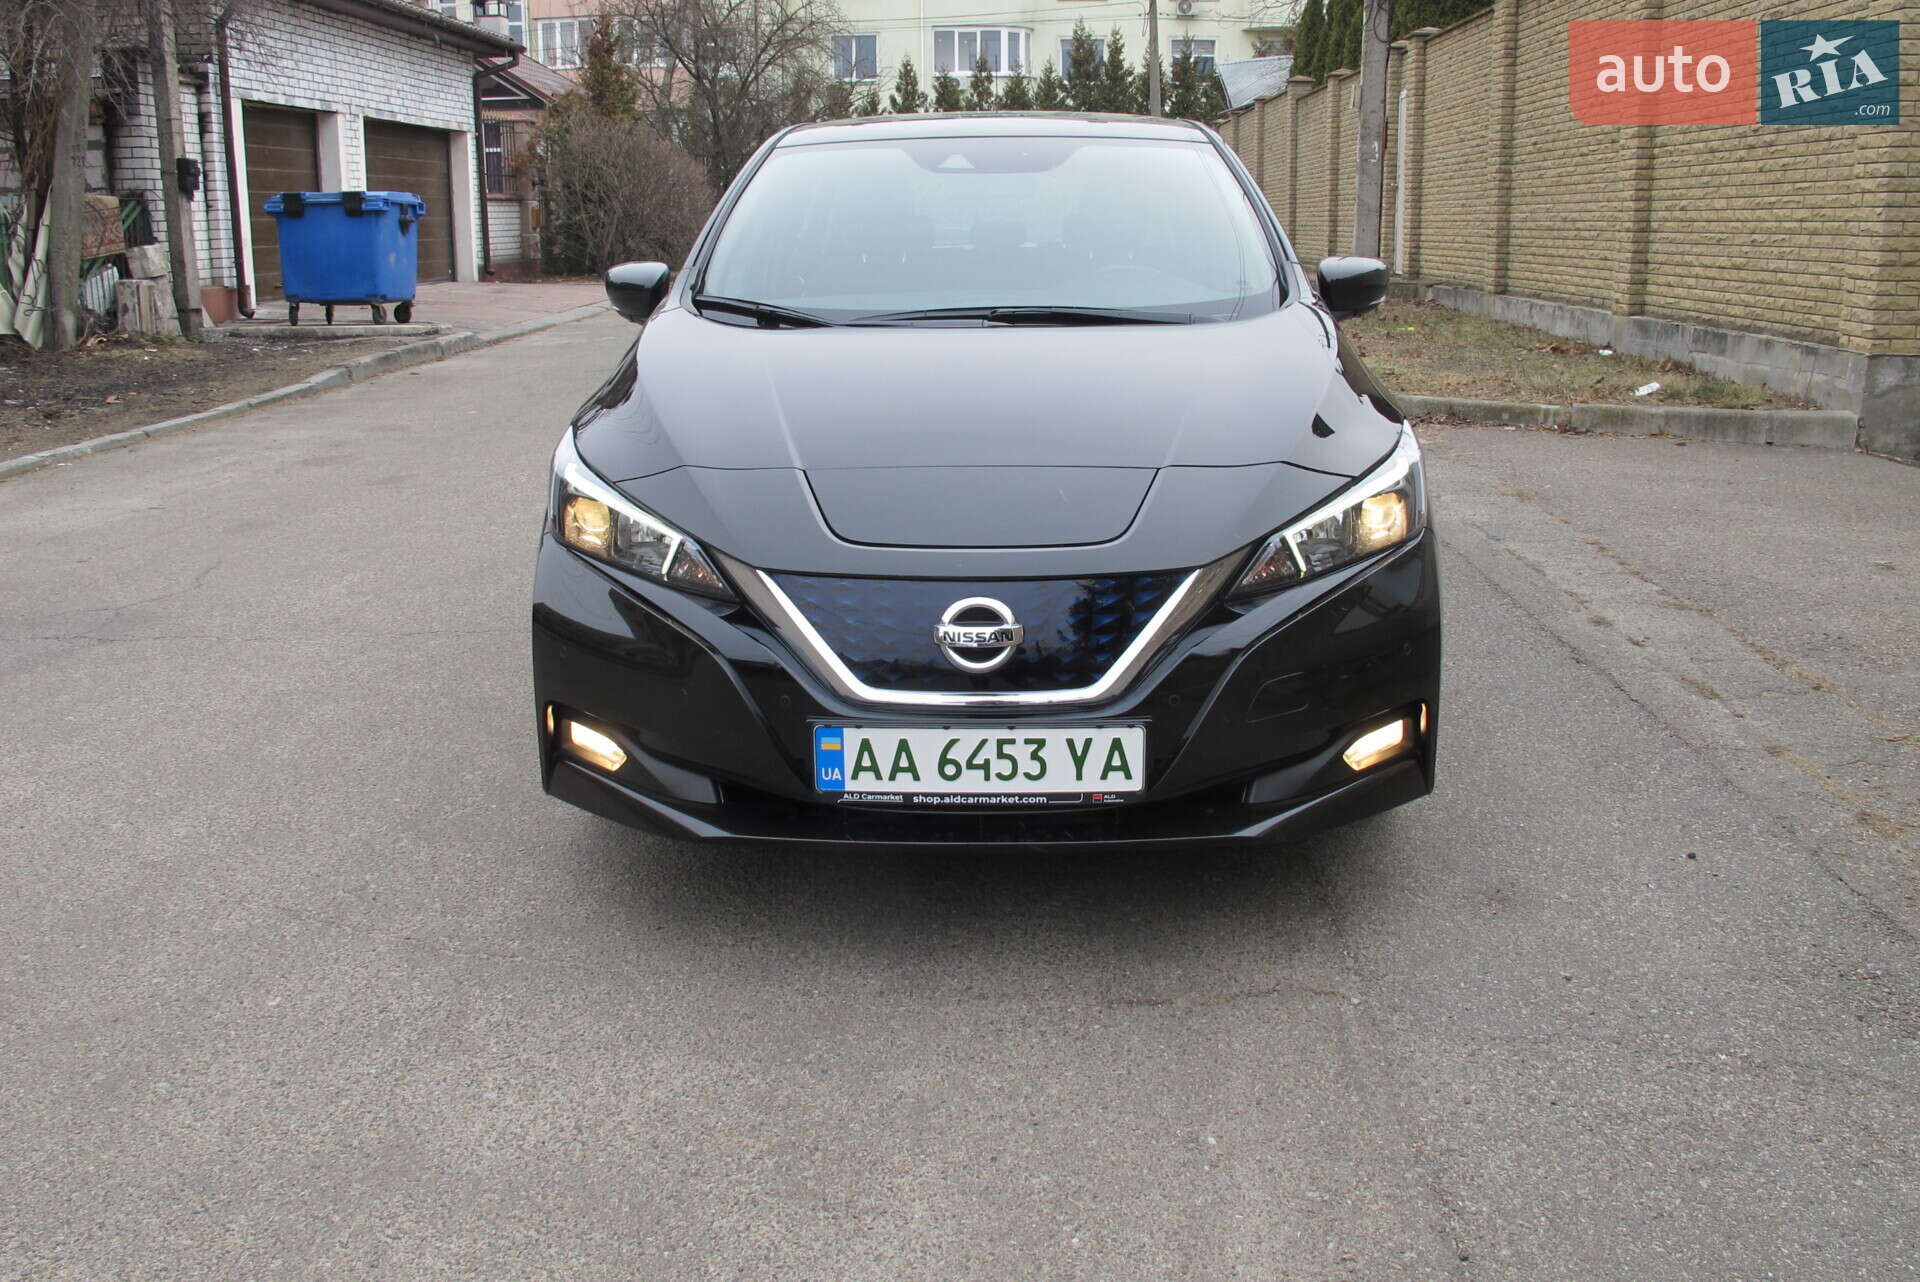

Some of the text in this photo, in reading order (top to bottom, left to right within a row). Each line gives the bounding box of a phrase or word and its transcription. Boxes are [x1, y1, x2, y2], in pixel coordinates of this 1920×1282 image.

[943, 630, 1014, 643] NISSAN
[850, 737, 1133, 781] AA 6453 YA
[821, 767, 842, 781] UA
[843, 792, 904, 801] ALD Carmarket
[912, 794, 1048, 805] shop.aldcarmarket.com
